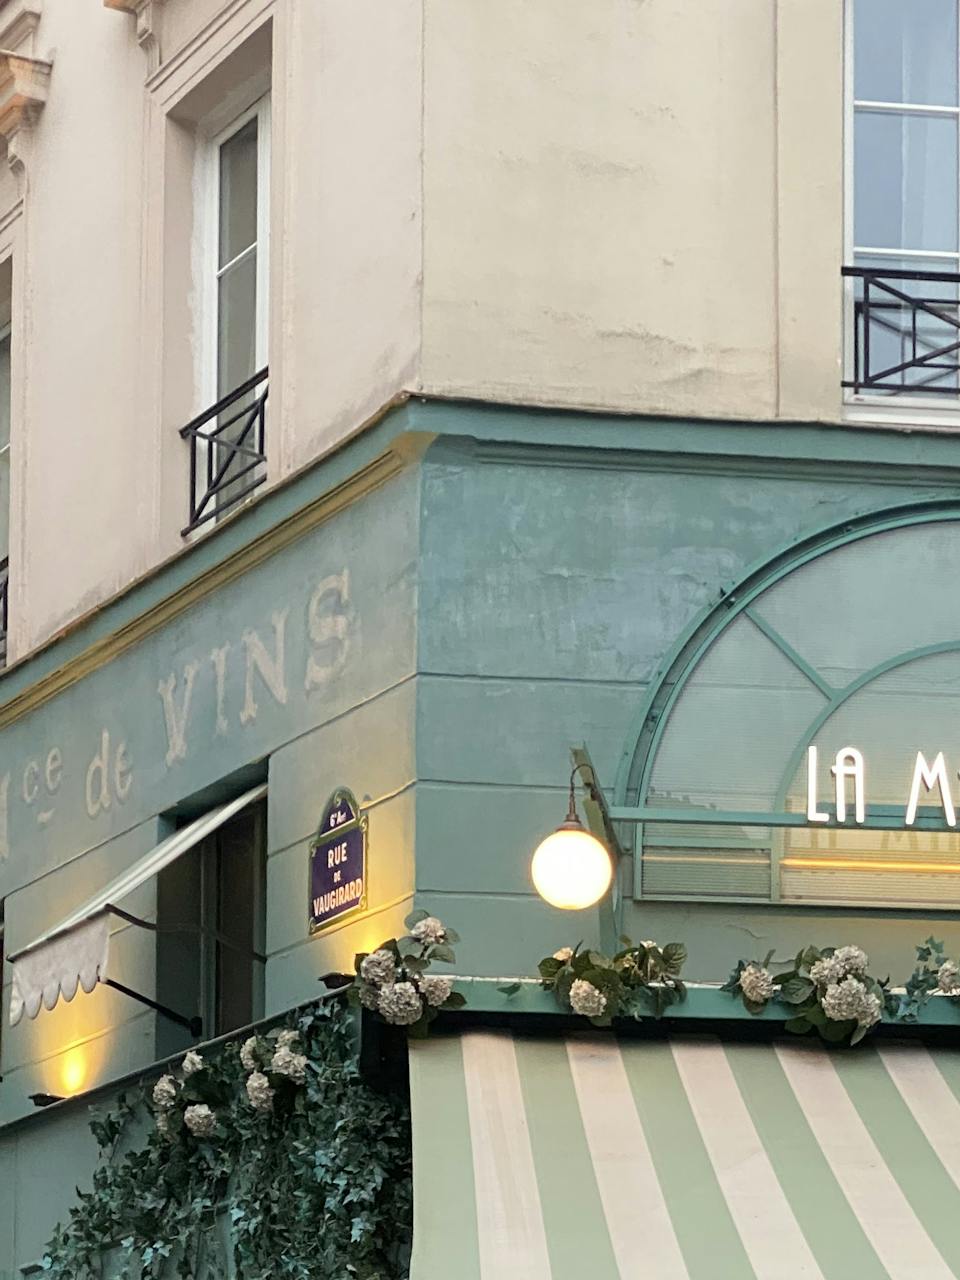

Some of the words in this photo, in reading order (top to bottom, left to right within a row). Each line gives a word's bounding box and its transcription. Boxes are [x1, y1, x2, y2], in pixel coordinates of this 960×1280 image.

[86, 728, 133, 816] de
[157, 568, 350, 768] VINS
[807, 745, 865, 824] LA
[328, 843, 347, 868] RUE
[333, 870, 341, 883] DE
[313, 877, 363, 917] VAUGIRARD
